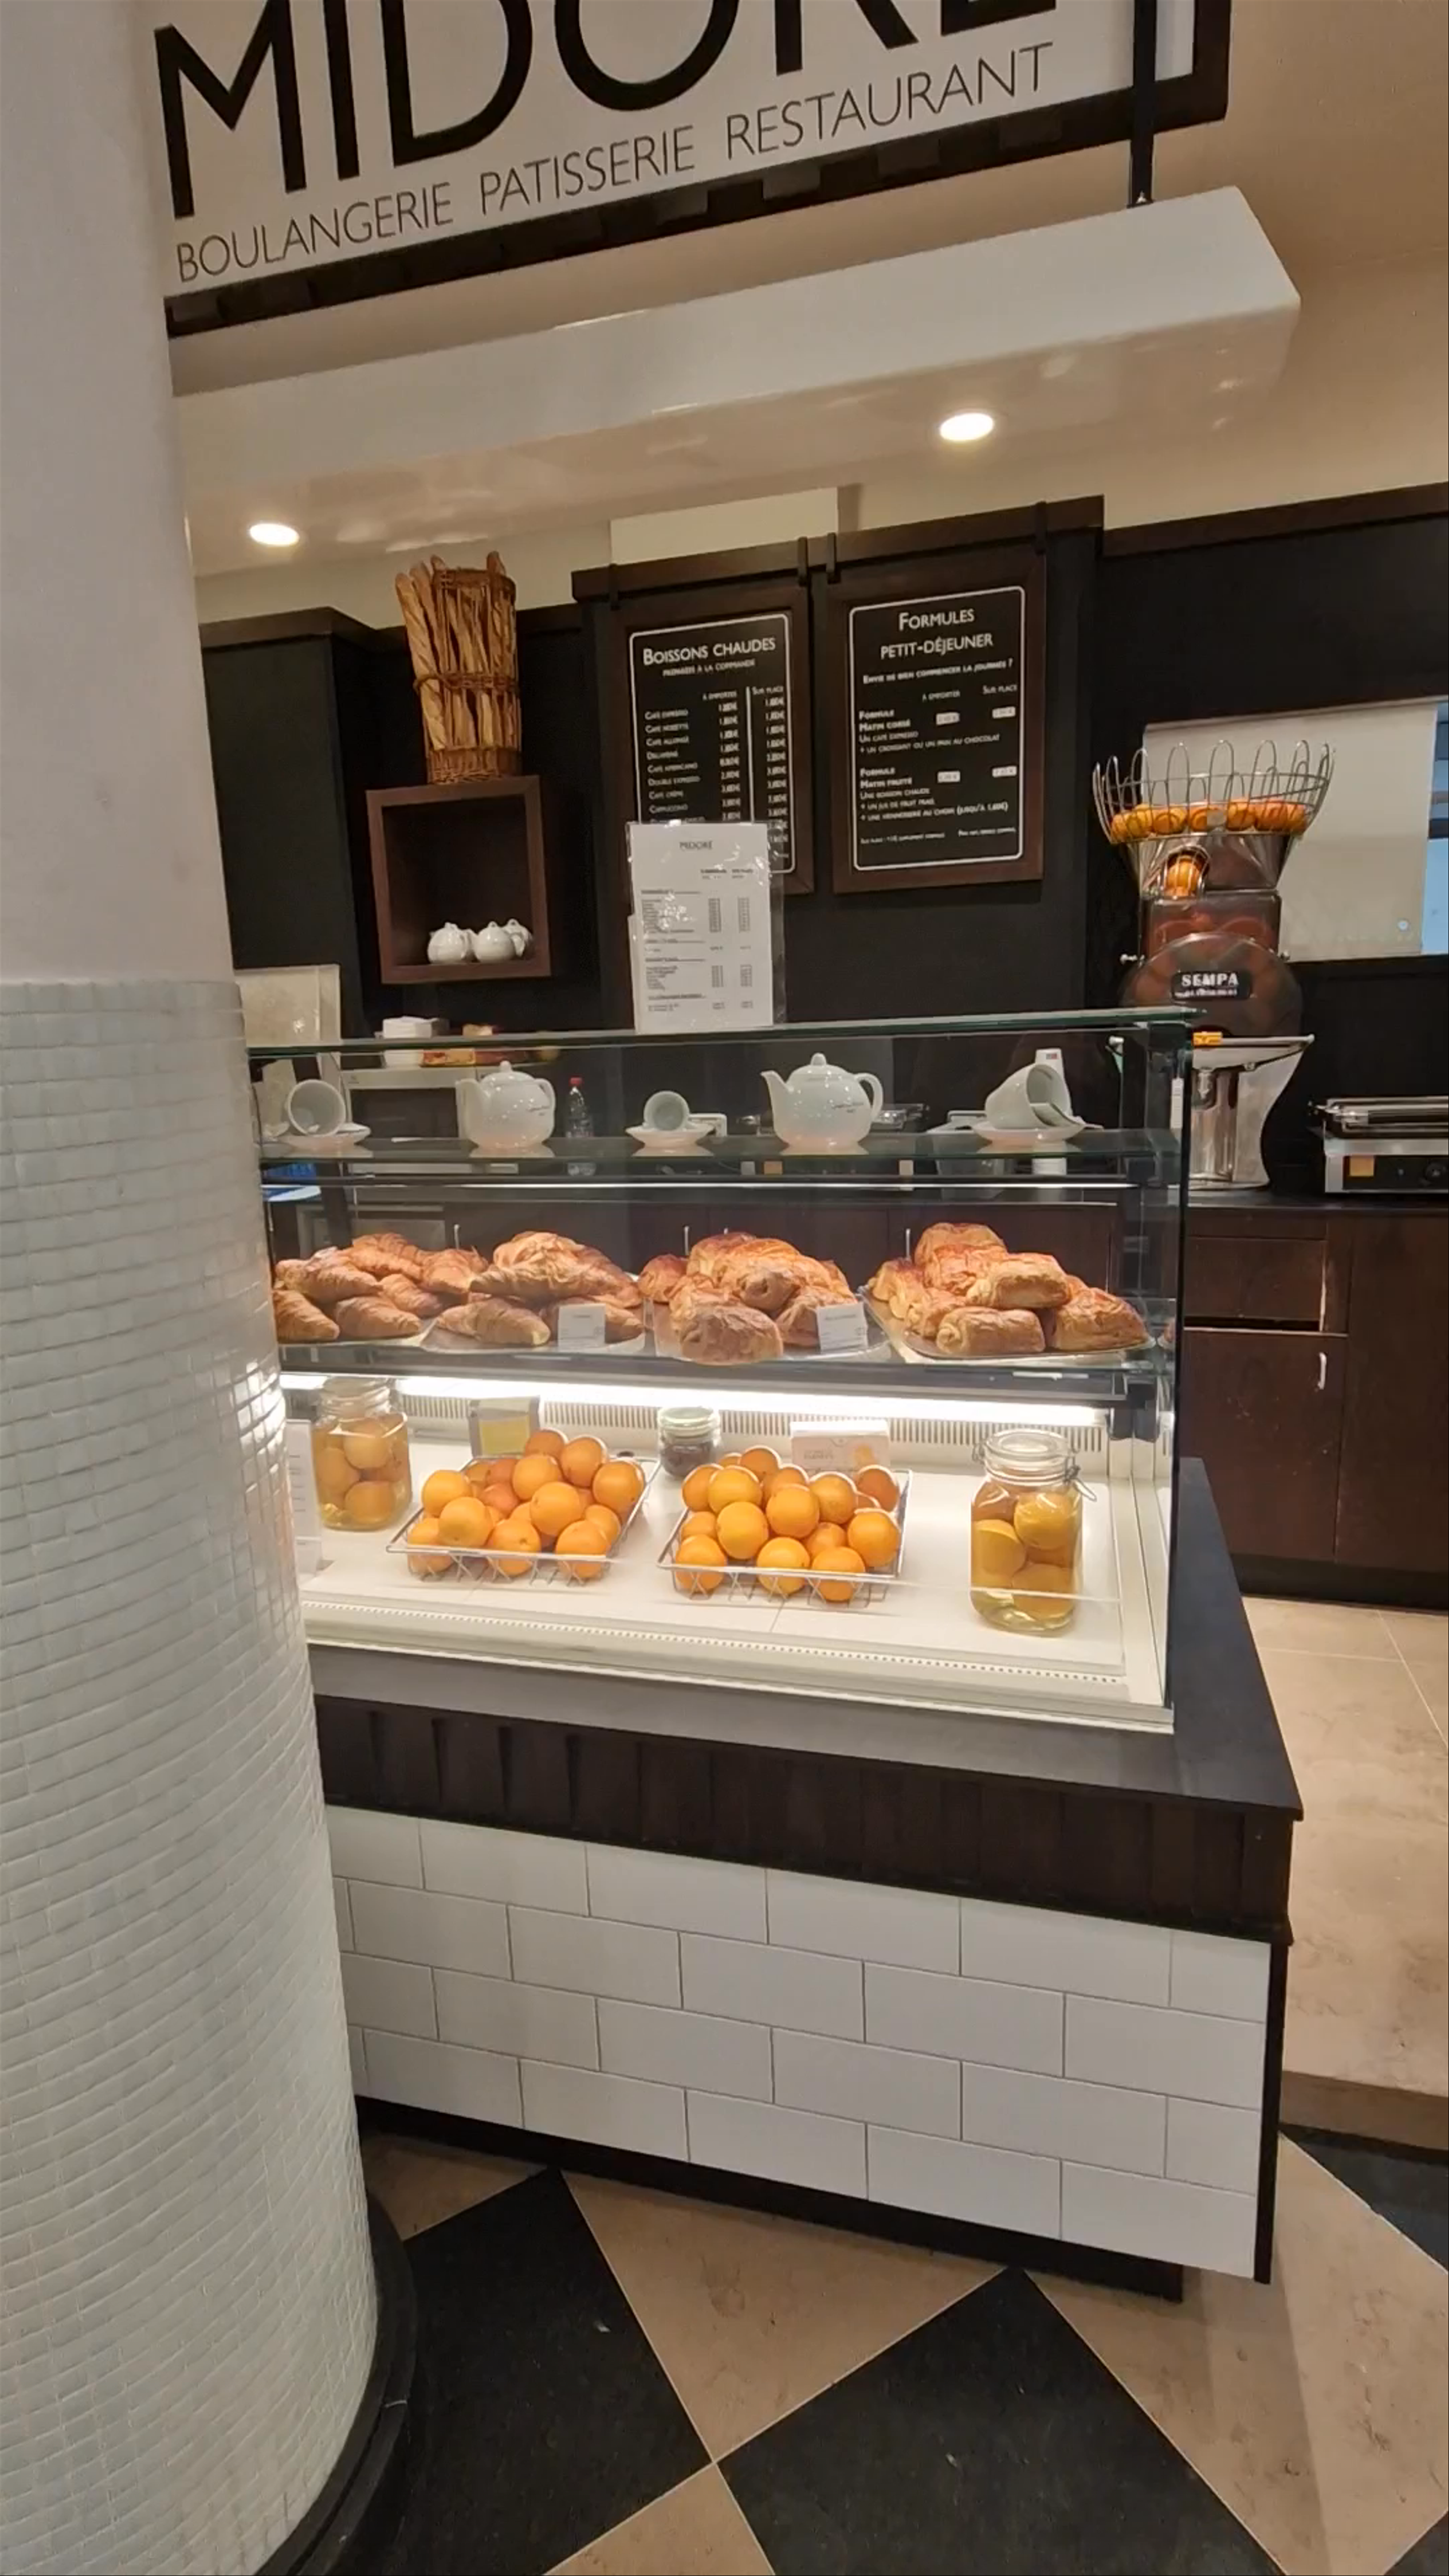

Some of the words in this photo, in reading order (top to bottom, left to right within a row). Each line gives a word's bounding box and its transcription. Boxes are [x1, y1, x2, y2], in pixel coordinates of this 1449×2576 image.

[154, 0, 1057, 220] MIDO
[177, 182, 453, 282] BOULANGERIE
[480, 125, 695, 215] PATISSERIE
[727, 42, 1053, 159] RESTAURANT
[899, 609, 975, 631] FORMULES
[643, 646, 708, 665] BOISSONS
[713, 638, 775, 657] CHAUDES
[881, 633, 993, 659] PETIT-DÉJEUNER
[916, 667, 961, 678] COMMENCER
[859, 710, 894, 720] FORMULE
[859, 723, 884, 732] MATIN
[860, 767, 895, 777] FORMULE
[860, 779, 885, 789] MATIN
[1181, 973, 1239, 987] SEMPA
